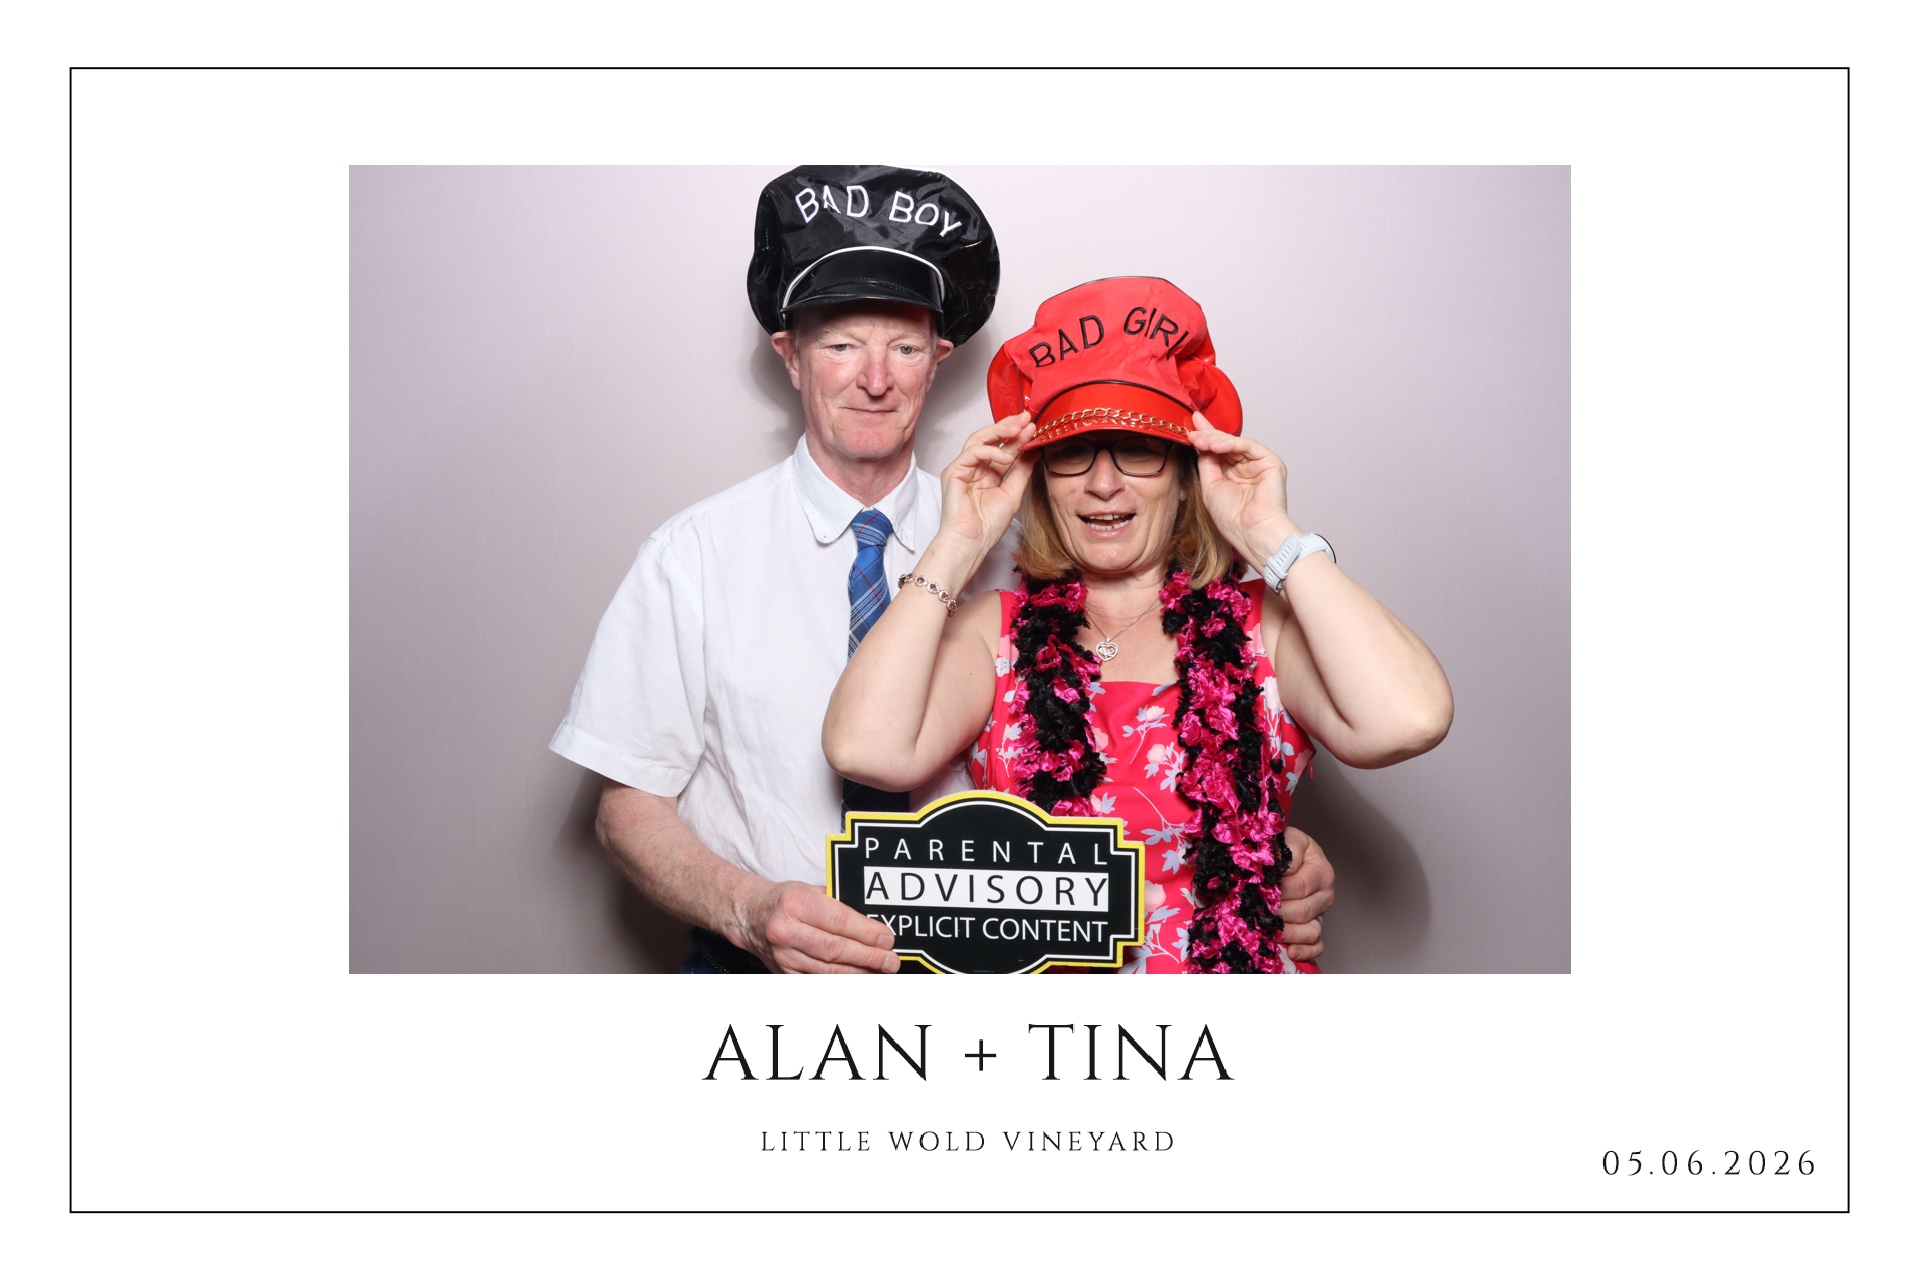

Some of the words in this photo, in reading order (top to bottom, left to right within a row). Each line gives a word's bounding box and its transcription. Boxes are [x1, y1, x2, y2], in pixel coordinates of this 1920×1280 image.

[795, 185, 869, 224] BAD
[889, 191, 962, 238] BOY
[1028, 315, 1105, 368] BAD
[865, 837, 1108, 865] PARENTAL
[865, 871, 1108, 907] ADVISORY
[866, 914, 976, 939] XPLICIT
[982, 918, 1108, 943] CONTENT
